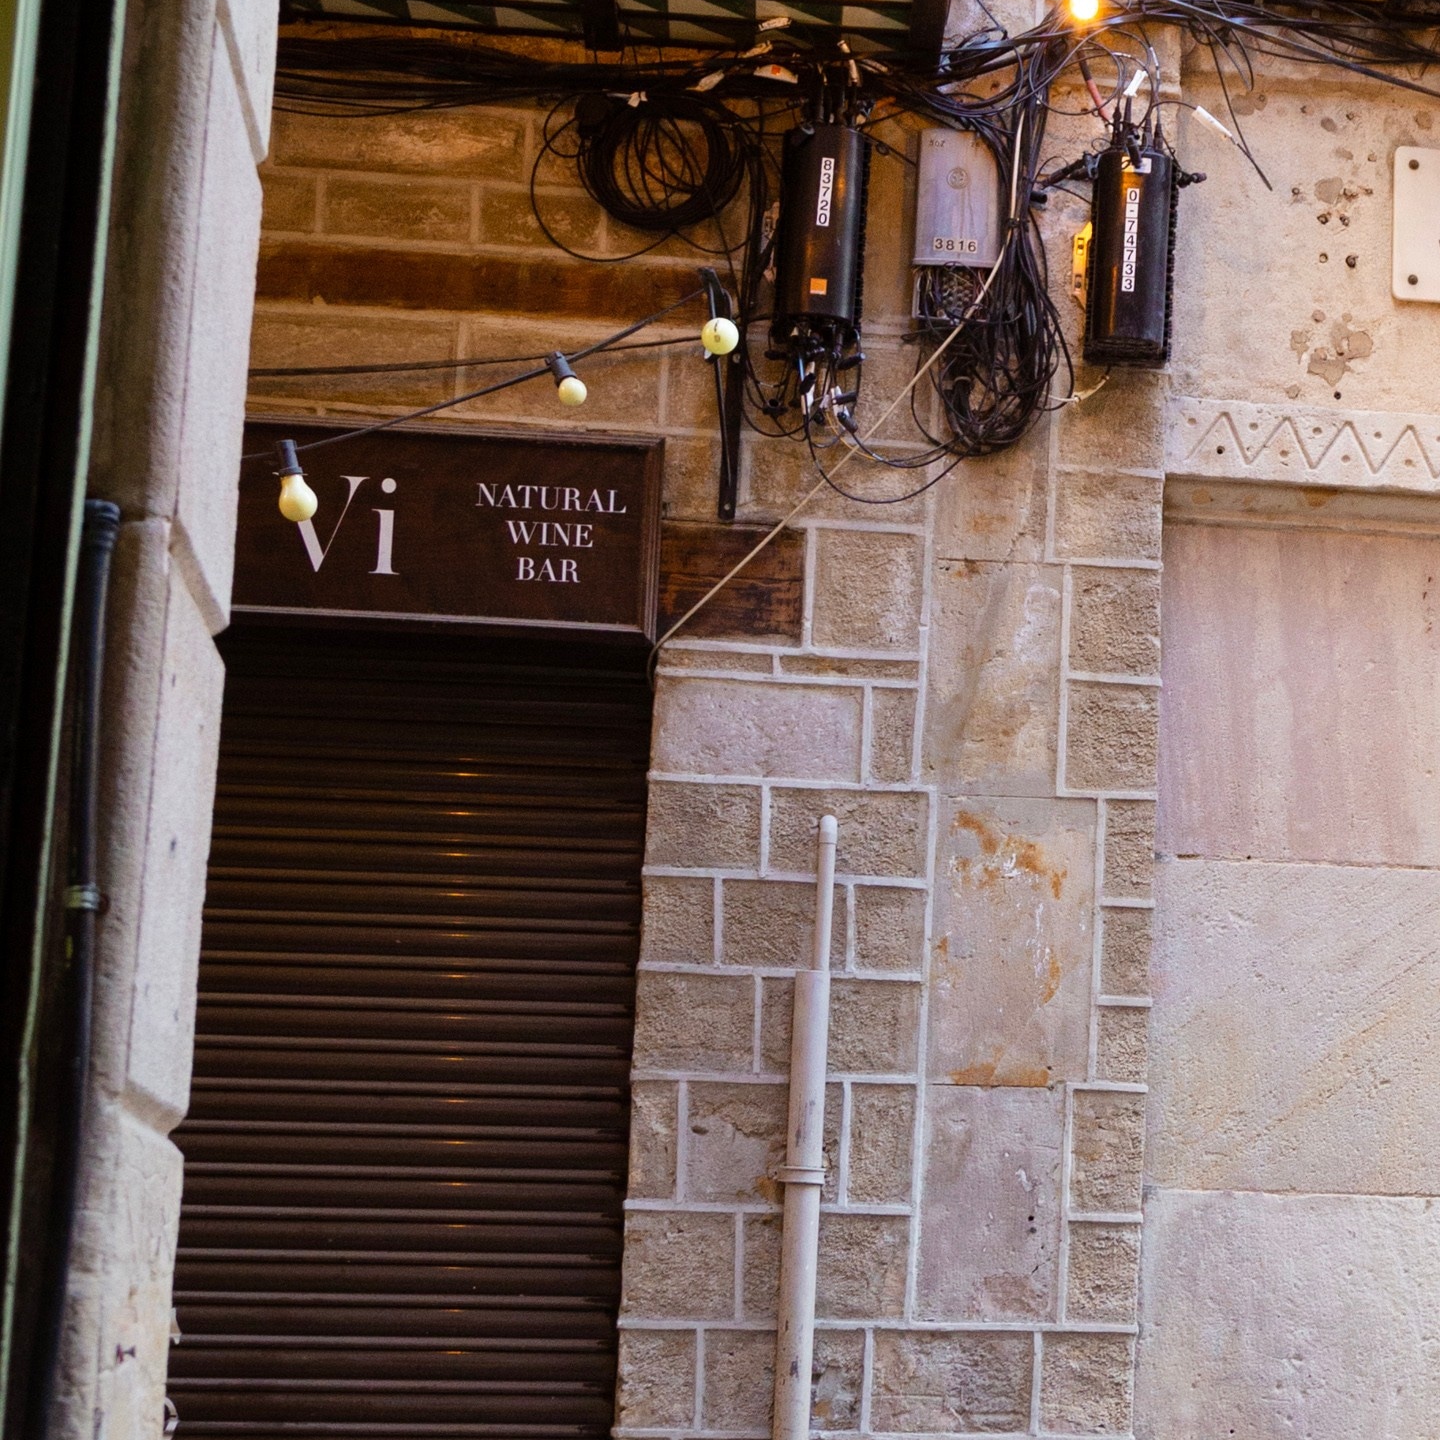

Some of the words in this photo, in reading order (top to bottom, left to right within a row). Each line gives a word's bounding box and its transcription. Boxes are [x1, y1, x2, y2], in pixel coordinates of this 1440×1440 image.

[818, 160, 832, 225] 83720
[935, 238, 976, 252] 3816
[1124, 190, 1138, 290] 0-74733
[475, 483, 627, 513] NATURAL
[273, 472, 400, 575] Vi
[507, 520, 593, 548] WINE
[515, 557, 580, 583] BAR
